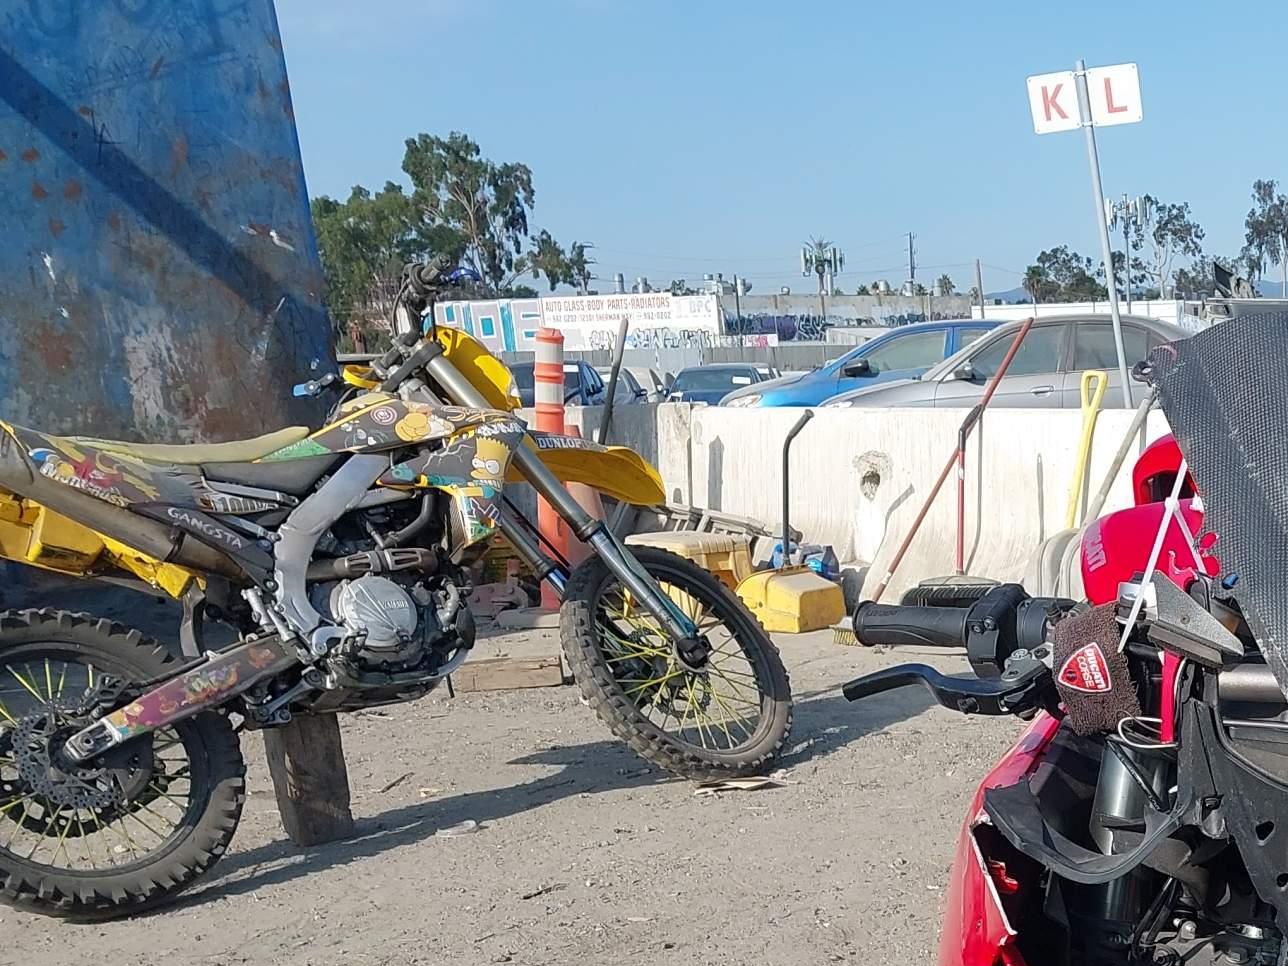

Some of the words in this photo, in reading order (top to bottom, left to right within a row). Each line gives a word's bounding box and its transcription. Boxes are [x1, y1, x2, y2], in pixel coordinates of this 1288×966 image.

[1041, 83, 1069, 121] K
[1104, 77, 1128, 113] L
[545, 301, 562, 312] AUTO
[536, 437, 582, 449] DUNLOP
[167, 506, 244, 550] GANGSTA
[1077, 655, 1094, 688] CORSE
[1084, 648, 1106, 689] DUCATI
